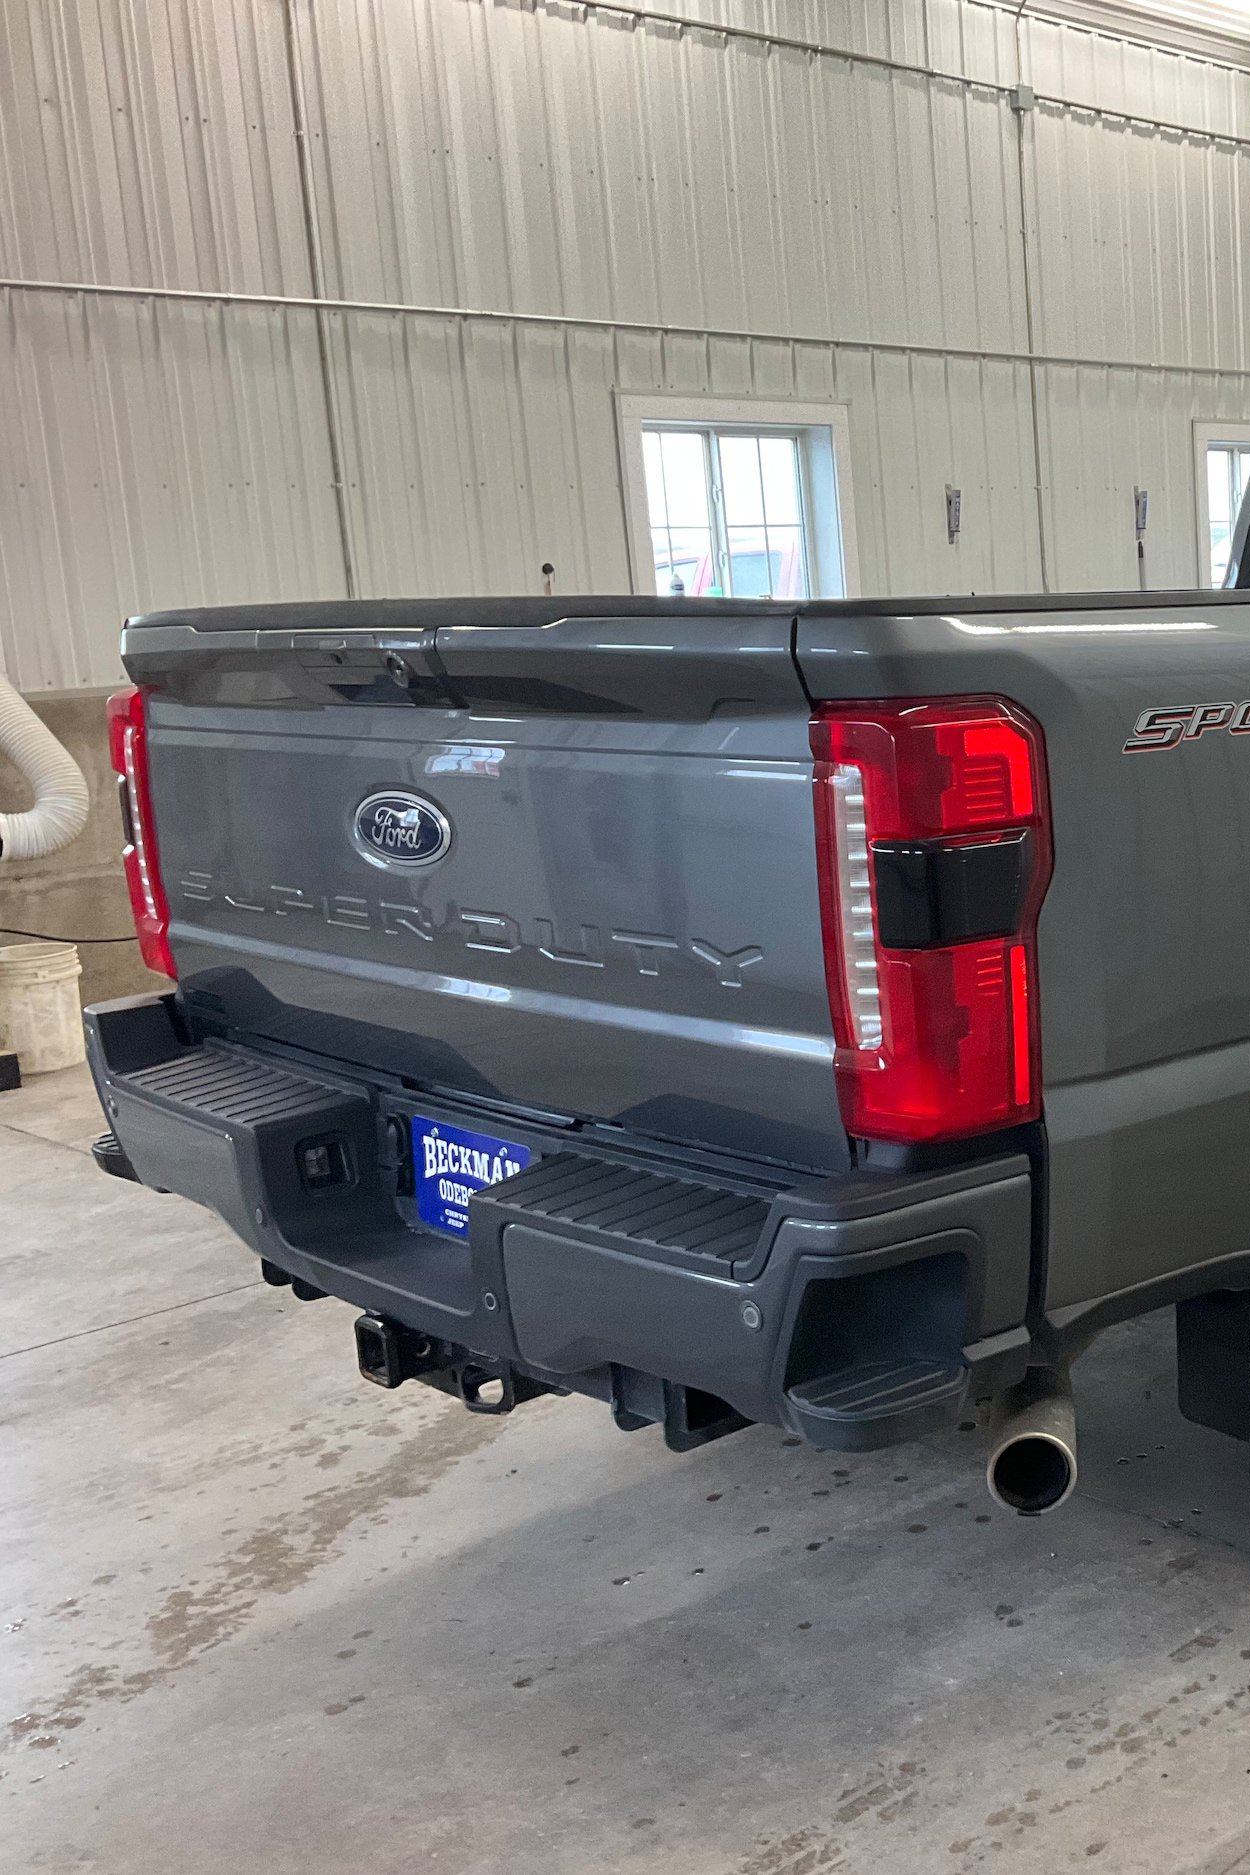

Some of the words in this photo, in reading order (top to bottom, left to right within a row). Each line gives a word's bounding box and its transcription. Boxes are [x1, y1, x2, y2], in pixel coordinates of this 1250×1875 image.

[372, 806, 421, 849] Ford
[181, 871, 433, 941] SUPER
[460, 906, 763, 987] DUTY
